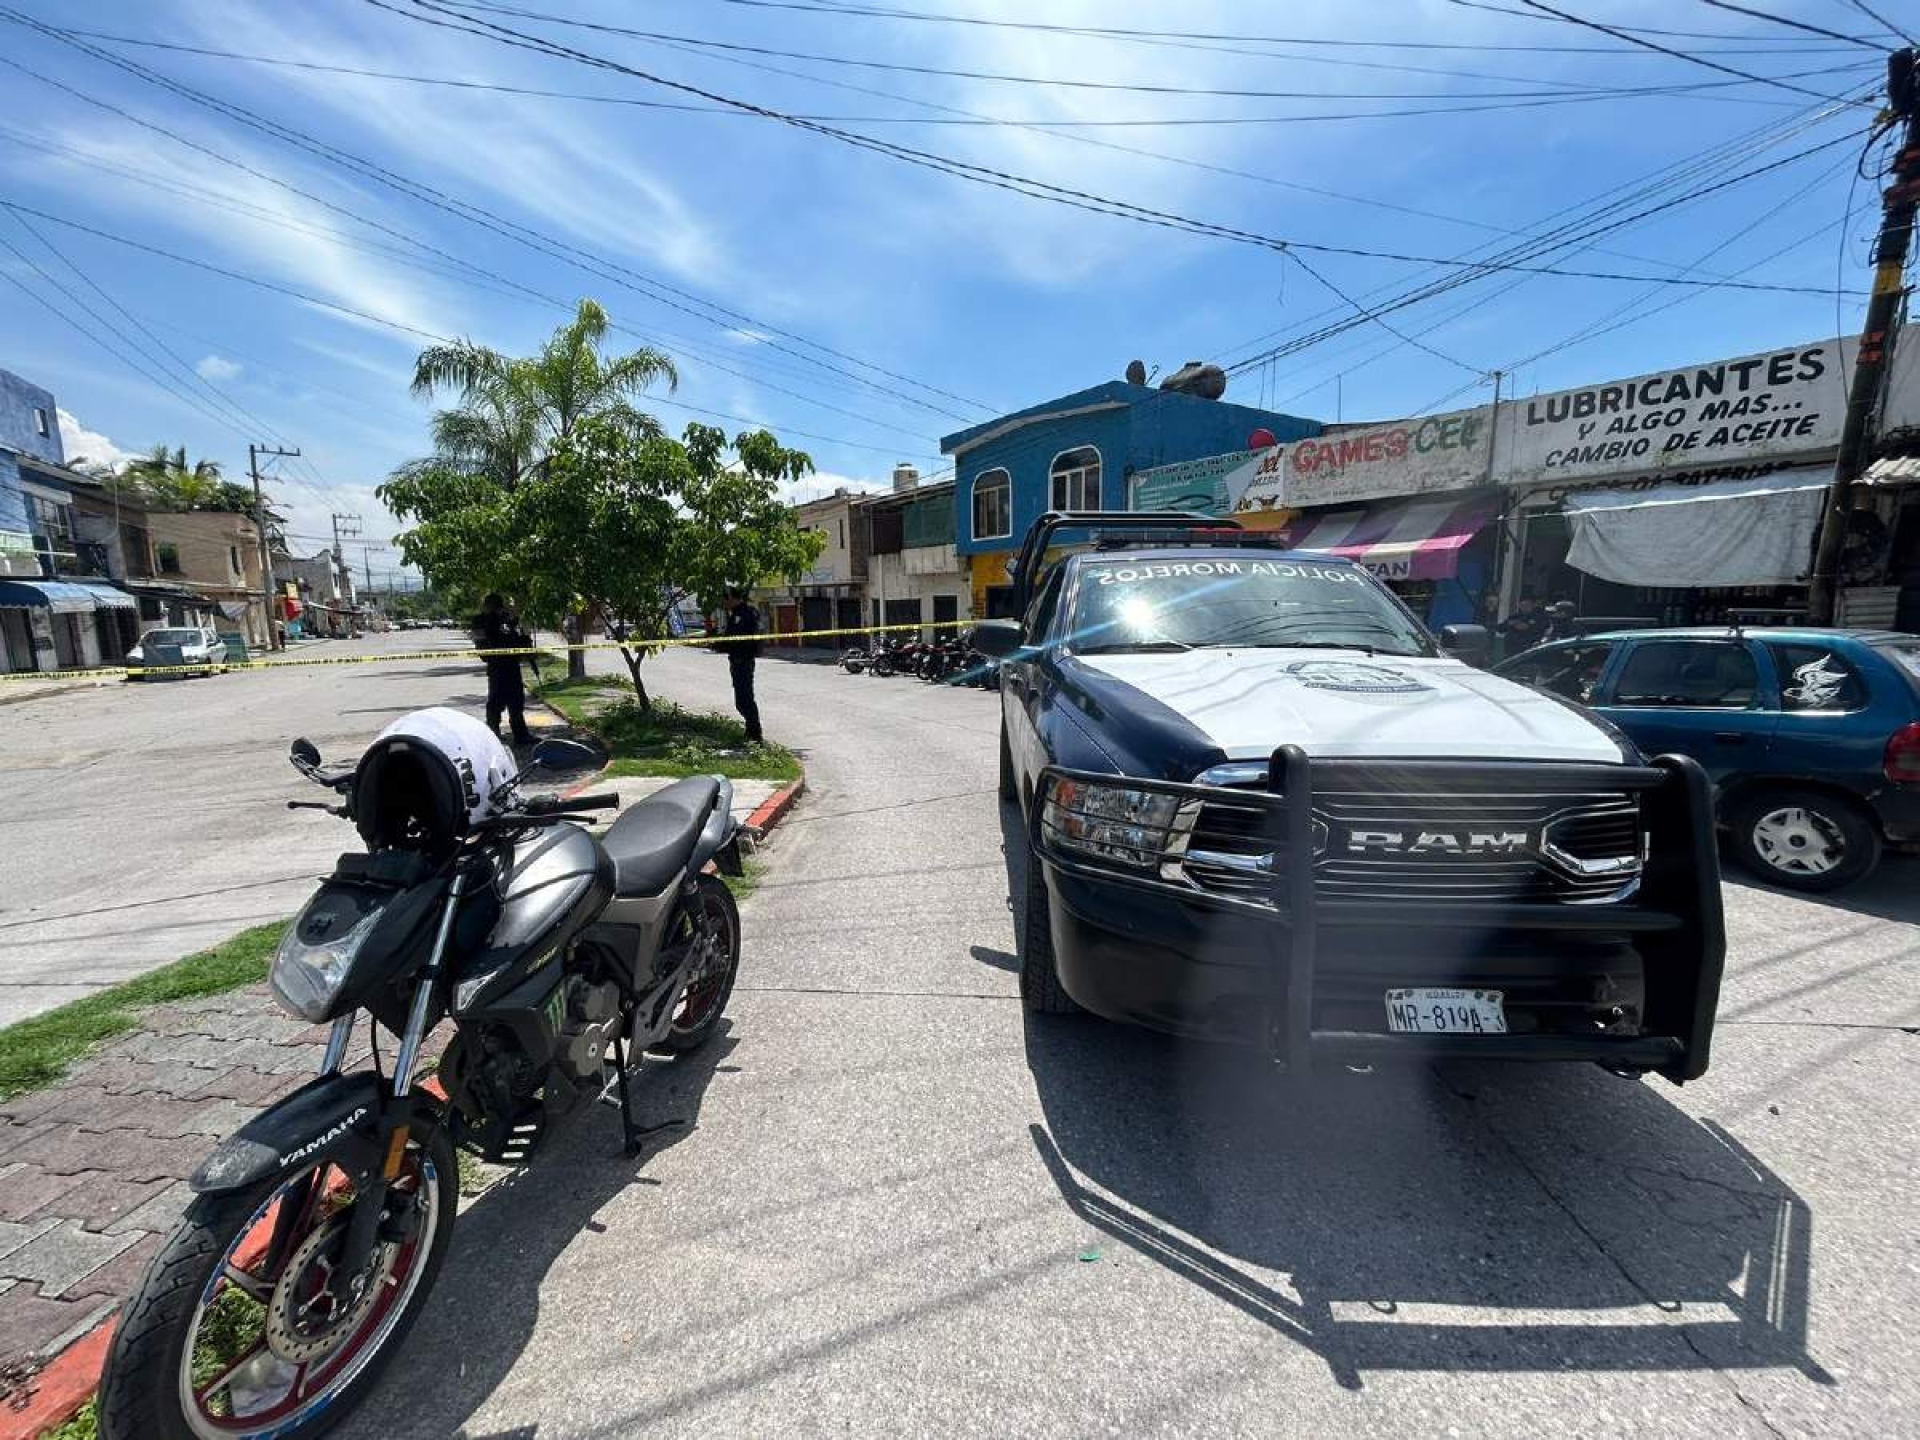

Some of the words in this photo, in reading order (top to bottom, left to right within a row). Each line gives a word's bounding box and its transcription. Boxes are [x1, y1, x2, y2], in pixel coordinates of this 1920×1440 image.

[1527, 348, 1825, 426] LUBRICANTES
[1545, 437, 1650, 468] CAMBIO
[1662, 430, 1702, 453] DE
[1704, 413, 1821, 447] ACEITE
[1578, 422, 1597, 441] Y
[1606, 407, 1687, 436] ALGO
[1293, 428, 1410, 473] GAMES
[1364, 561, 1409, 578] FAN
[1349, 831, 1528, 854] RAM
[279, 1107, 368, 1167] YAMAHA
